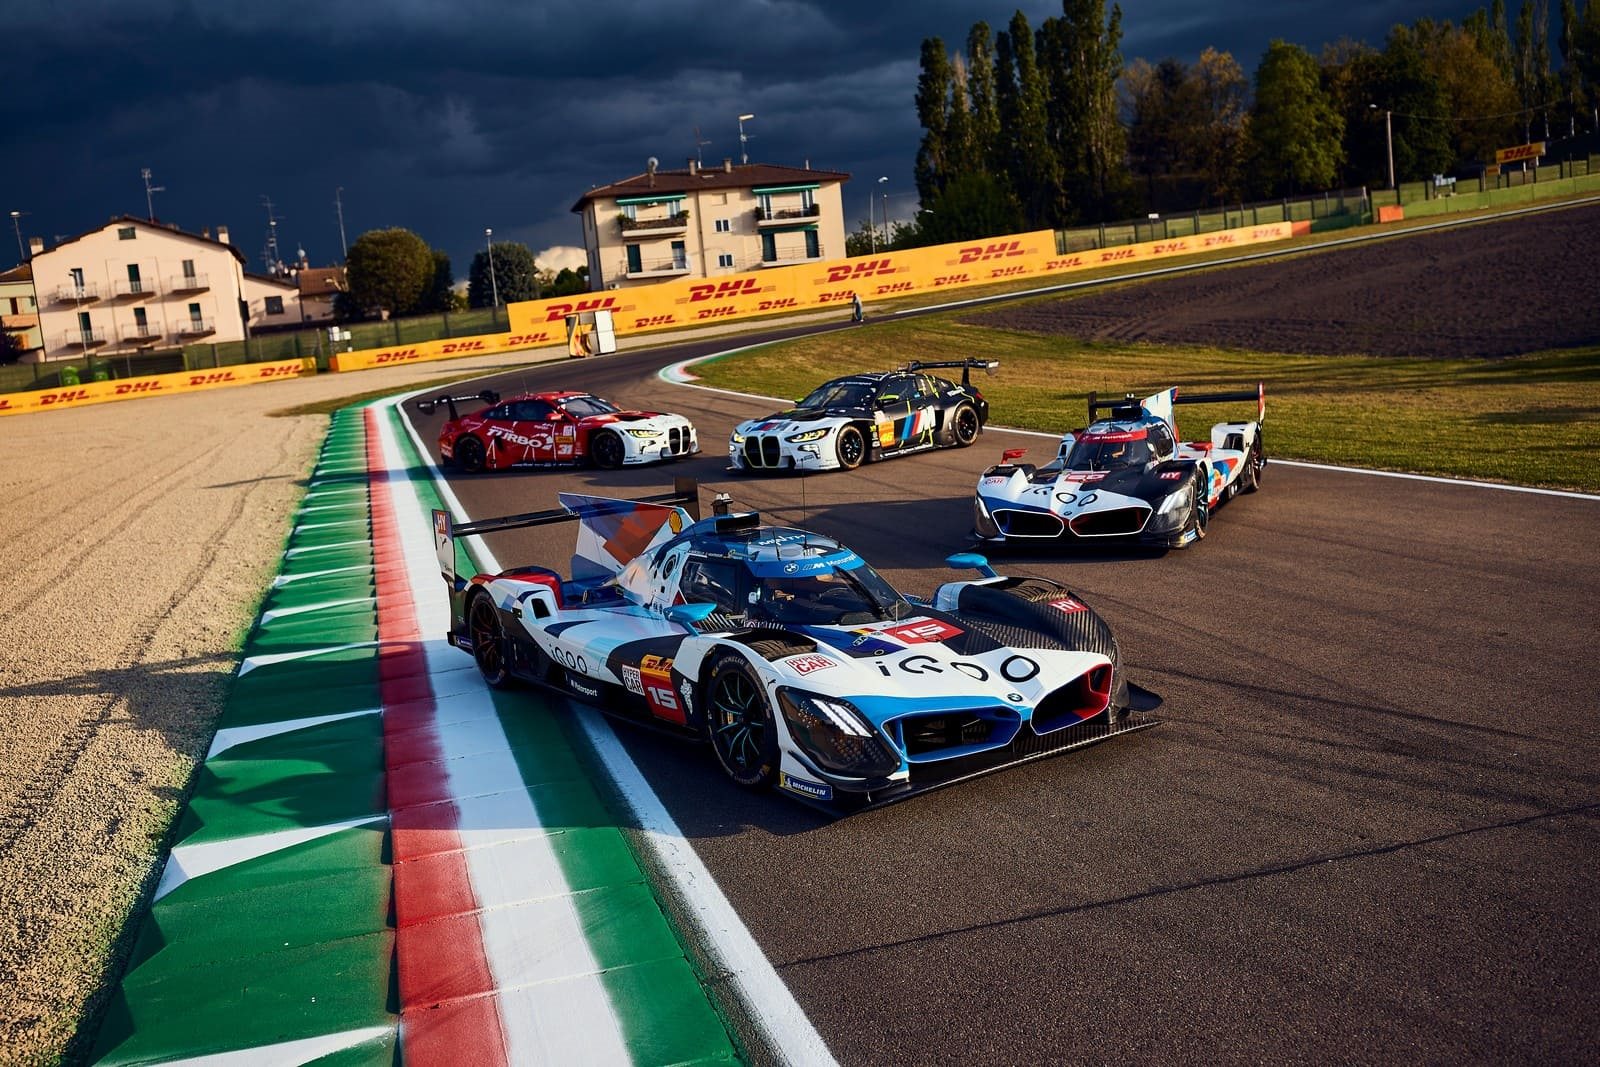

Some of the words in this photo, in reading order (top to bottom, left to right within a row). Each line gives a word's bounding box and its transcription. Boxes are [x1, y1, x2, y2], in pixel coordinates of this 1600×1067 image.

[1503, 145, 1535, 160] DHL
[1204, 234, 1236, 246] DHL
[959, 241, 1025, 264] DHL
[1154, 242, 1187, 254] DHL
[1101, 249, 1136, 262] DHL
[827, 259, 897, 282] DHL
[1046, 257, 1083, 270] DHL
[992, 265, 1027, 278] DHL
[934, 273, 971, 286] DHL
[689, 278, 762, 302] DHL
[877, 281, 915, 294] DHL
[818, 290, 855, 302] DHL
[545, 297, 622, 322] DHL
[759, 298, 798, 311] DHL
[697, 305, 738, 319] DHL
[635, 314, 676, 328] DHL
[509, 332, 550, 346] DHL
[442, 340, 486, 353] DHL
[376, 350, 420, 363] DHL
[260, 364, 304, 377] DHL
[190, 371, 236, 386] DHL
[115, 380, 163, 395] DHL
[39, 389, 90, 405] DHL
[1160, 472, 1179, 480] HY
[437, 513, 447, 533] HY
[826, 554, 857, 567] Motorsport
[1057, 599, 1079, 612] HY
[896, 623, 946, 640] 15
[549, 643, 588, 674] iQOO
[789, 655, 823, 666] HYPER
[796, 659, 833, 673] CAR
[875, 655, 1041, 683] iQOO
[622, 667, 640, 681] HYPER
[625, 677, 644, 695] CAR
[648, 686, 678, 710] 15
[792, 781, 826, 796] MICHELIN
